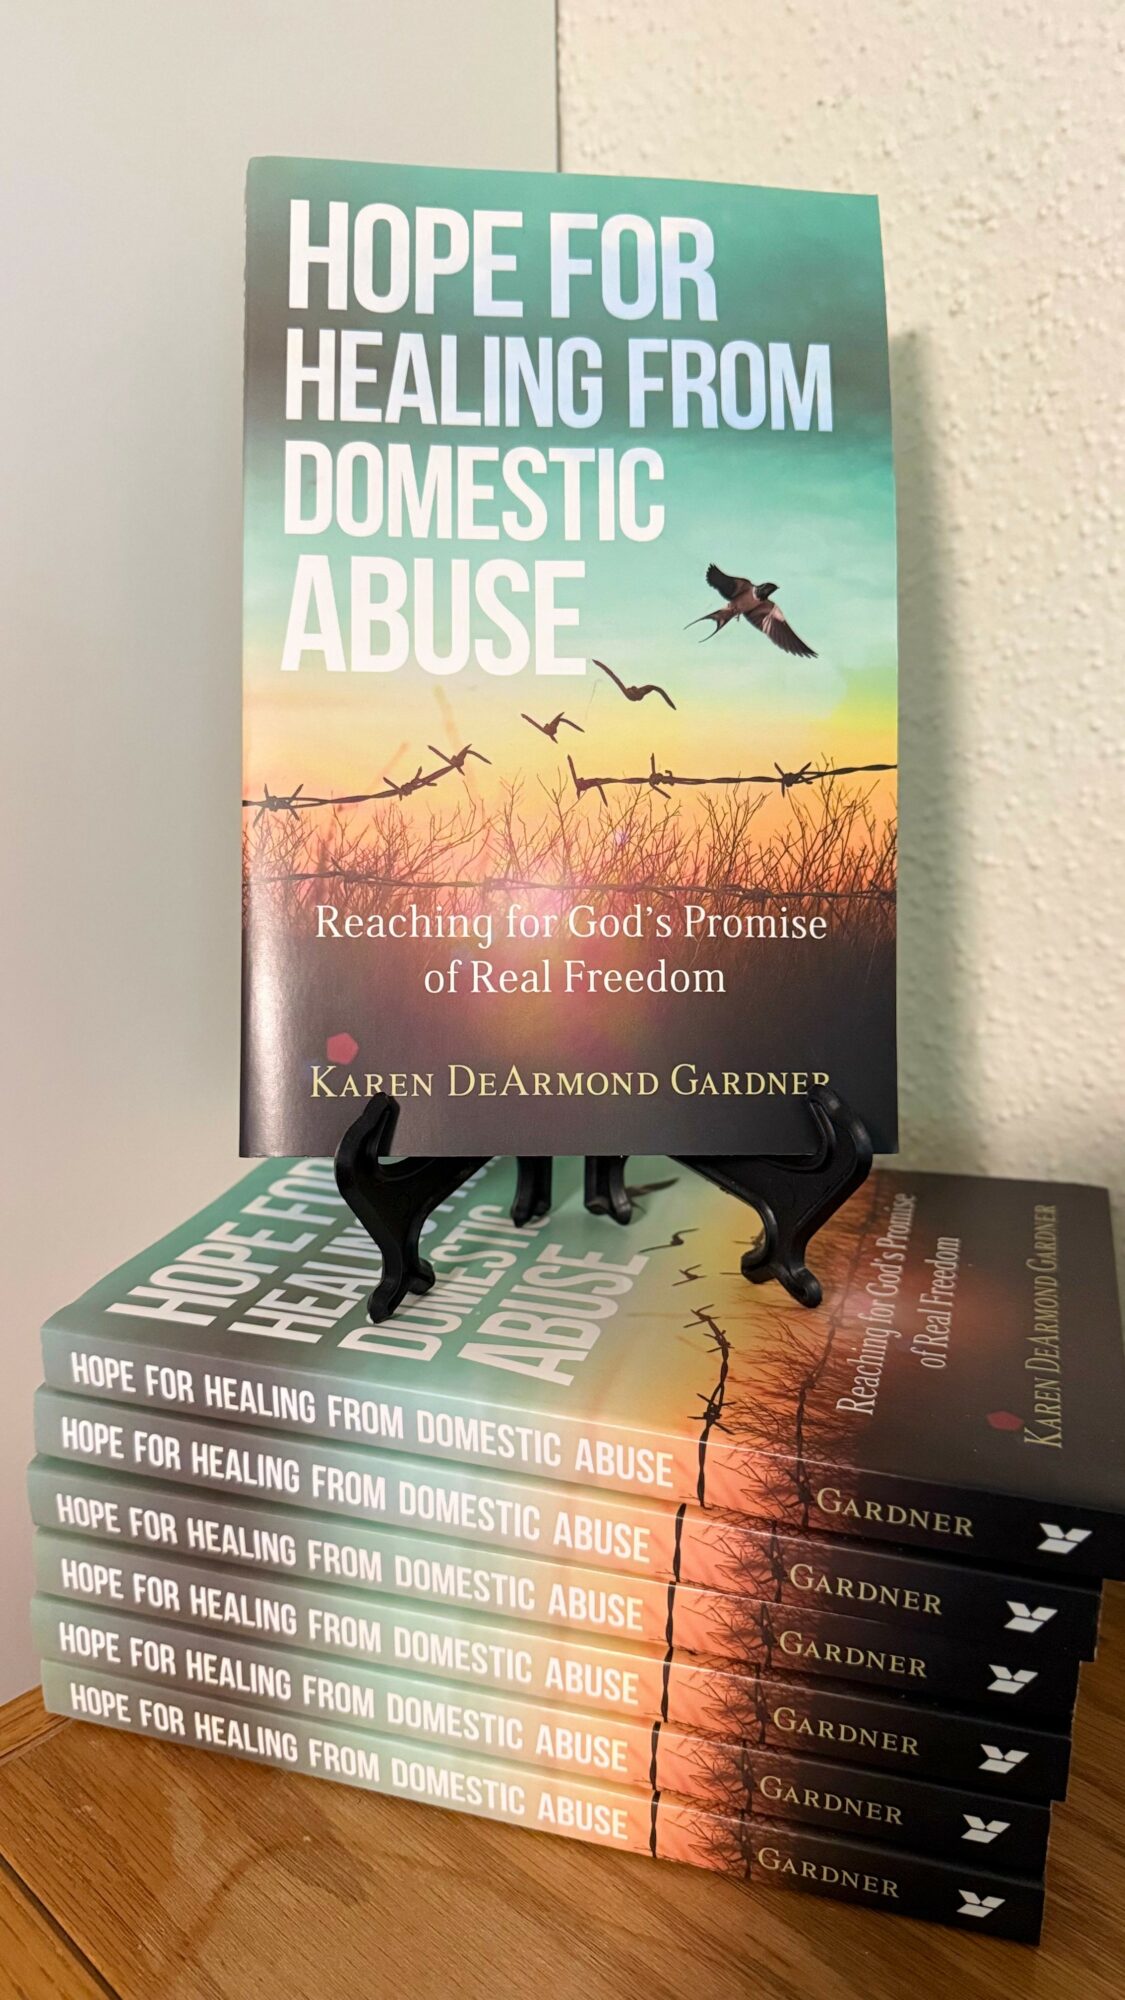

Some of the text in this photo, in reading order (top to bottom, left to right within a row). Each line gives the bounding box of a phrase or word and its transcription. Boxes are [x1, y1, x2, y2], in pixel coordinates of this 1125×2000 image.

[288, 199, 718, 321] HOPE FOR
[285, 328, 834, 432] HEALING FROM
[284, 440, 666, 543] DOMESTIC
[280, 554, 587, 676] ABUSE
[315, 903, 829, 949] Reaching for God's Promise
[424, 960, 727, 994] of Real Freedom
[105, 1220, 319, 1327] HOPE
[336, 1203, 550, 1362] DOMESTIC
[876, 1192, 917, 1251] Promise
[457, 1243, 650, 1387] ABUSE
[858, 1298, 896, 1324] for
[910, 1236, 961, 1370] of Real Freedom
[70, 1351, 673, 1487] HOPE FOR HEALING FROM DOMESTIC ABUSE
[836, 1325, 902, 1416] Reaching
[61, 1416, 650, 1562] HOPE FOR HEALING FROM DOMESTIC ABUSE
[56, 1493, 643, 1631] HOPE FOR HEALING FROM DOMESTIC ABUSE
[61, 1558, 639, 1705] HOPE FOR HEALING FROM DOMESTIC ABUSE
[59, 1621, 628, 1772] HOPE FOR HEALING FROM DOMESTIC ABUSE
[69, 1682, 628, 1840] HOPE FOR HEALING FROM DOMESTIC ABUSE
